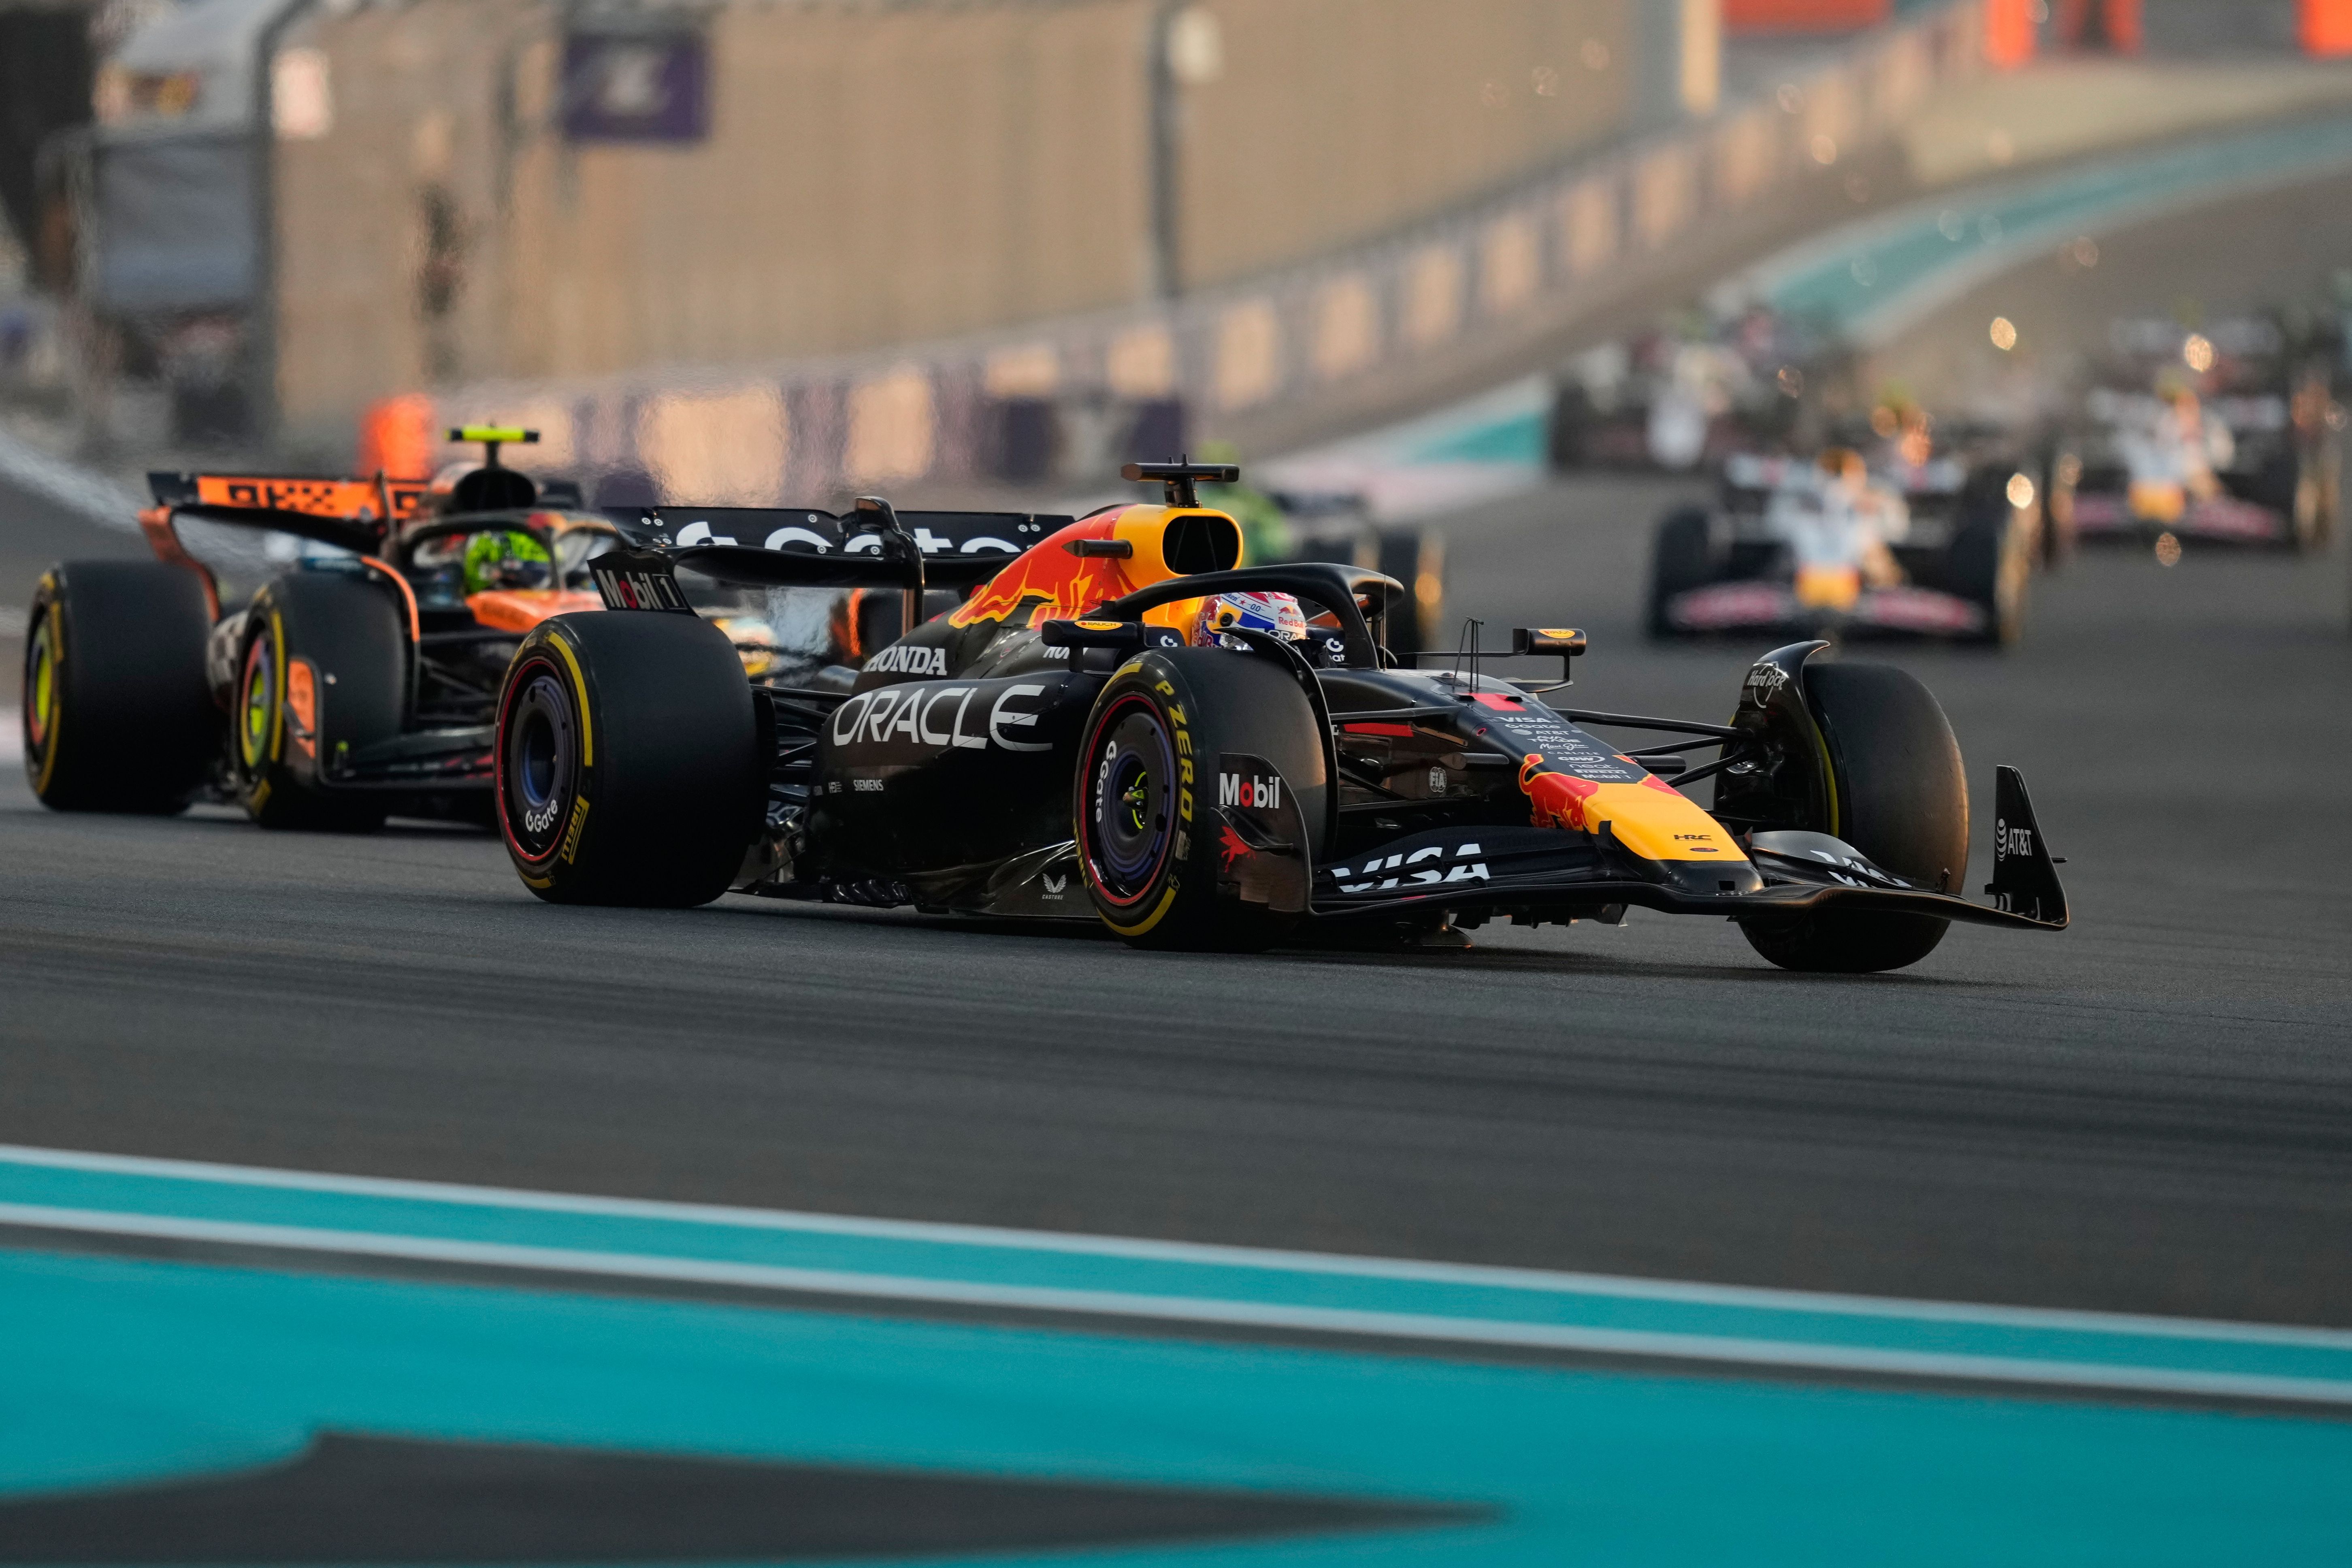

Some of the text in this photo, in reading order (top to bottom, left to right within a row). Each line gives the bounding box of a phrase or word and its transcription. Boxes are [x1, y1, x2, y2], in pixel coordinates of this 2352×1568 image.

[596, 569, 679, 610] Mobil 1
[1278, 617, 1304, 628] Red Bull
[862, 646, 947, 676] HONDA
[1747, 670, 1771, 687] Hard
[833, 684, 1053, 752] ORACLE
[1154, 680, 1175, 697] P
[1168, 703, 1194, 822] ZERO
[853, 780, 884, 791] SIEMENS
[1219, 773, 1280, 809] Mobil
[1430, 771, 1446, 787] FIA
[561, 794, 590, 865] PIRELLI
[2008, 828, 2032, 856] AT&T
[1331, 843, 1491, 893] VISA
